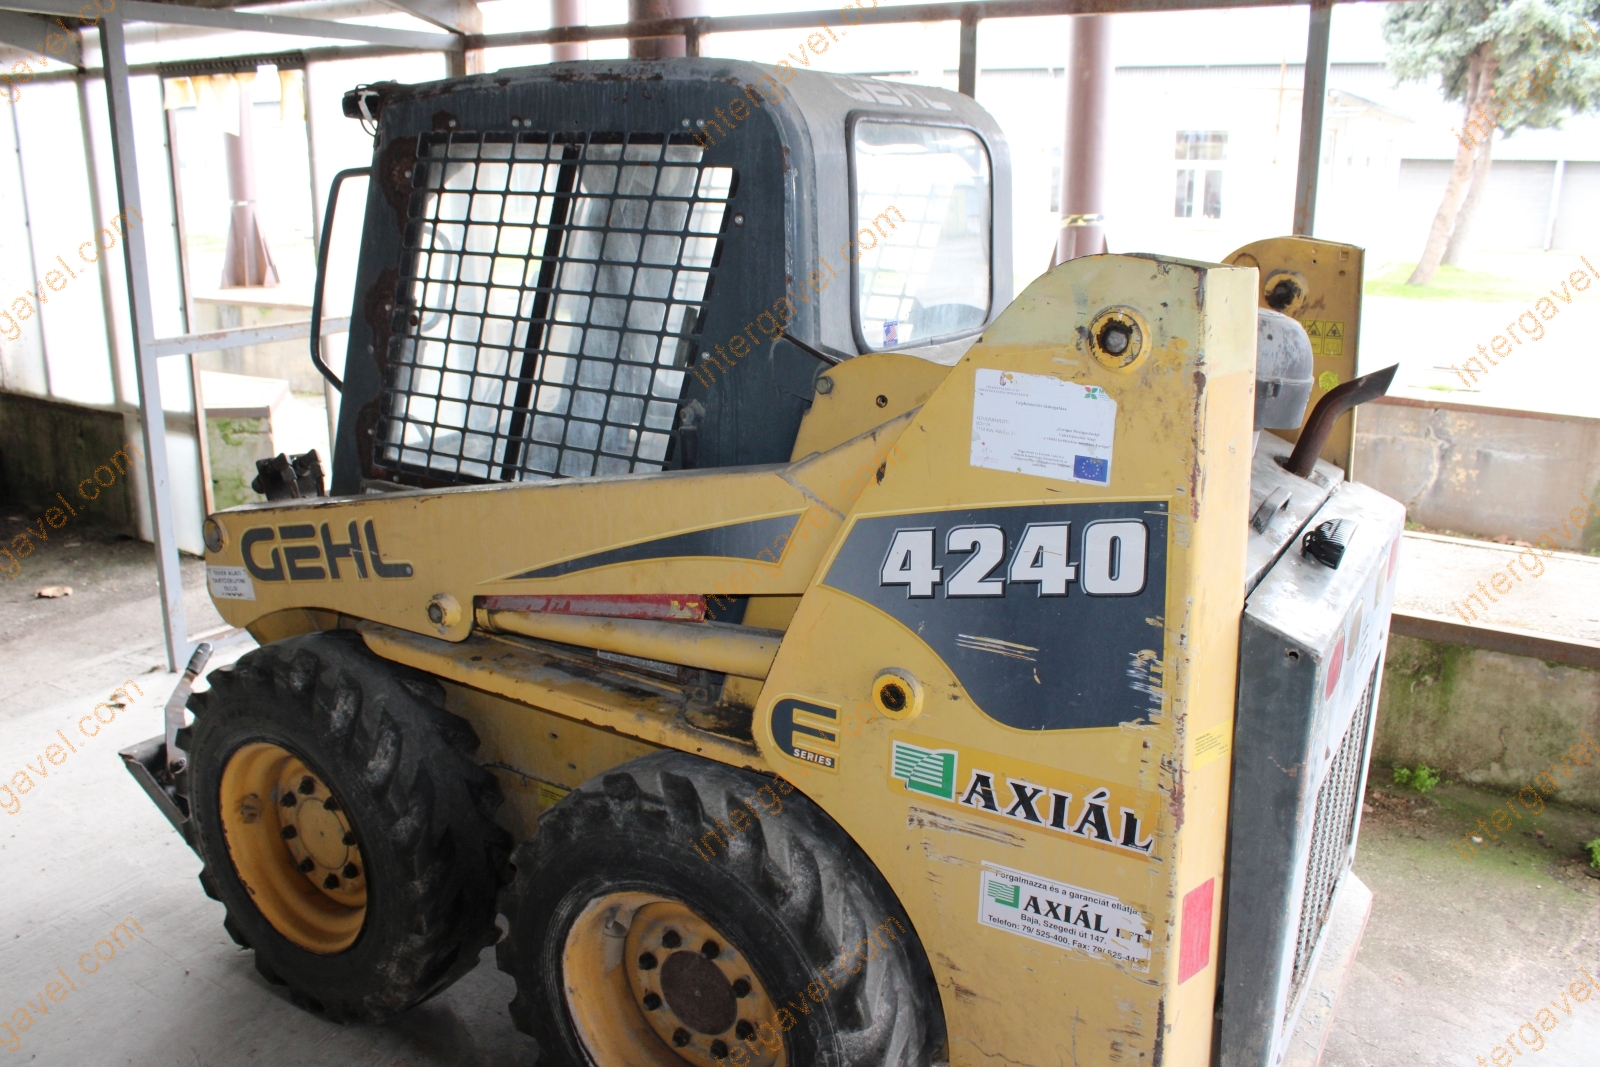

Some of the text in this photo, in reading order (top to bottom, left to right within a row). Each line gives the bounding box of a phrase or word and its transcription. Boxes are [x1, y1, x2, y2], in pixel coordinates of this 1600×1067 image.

[241, 519, 414, 582] GEHL
[879, 518, 1149, 600] 4240
[793, 748, 832, 767] SERIES
[960, 772, 1154, 853] AXIÁL
[995, 870, 1048, 890] Forgalmazza
[1049, 885, 1060, 894] és
[1069, 891, 1110, 908] garanciát
[988, 914, 1020, 930] Telefon:
[1021, 924, 1035, 934] 79/
[1035, 929, 1070, 946] 525-400,
[1072, 939, 1090, 951] Fax:
[1020, 913, 1107, 945] Baja, Szegedi út 147.
[1022, 895, 1110, 934] AXIÁL
